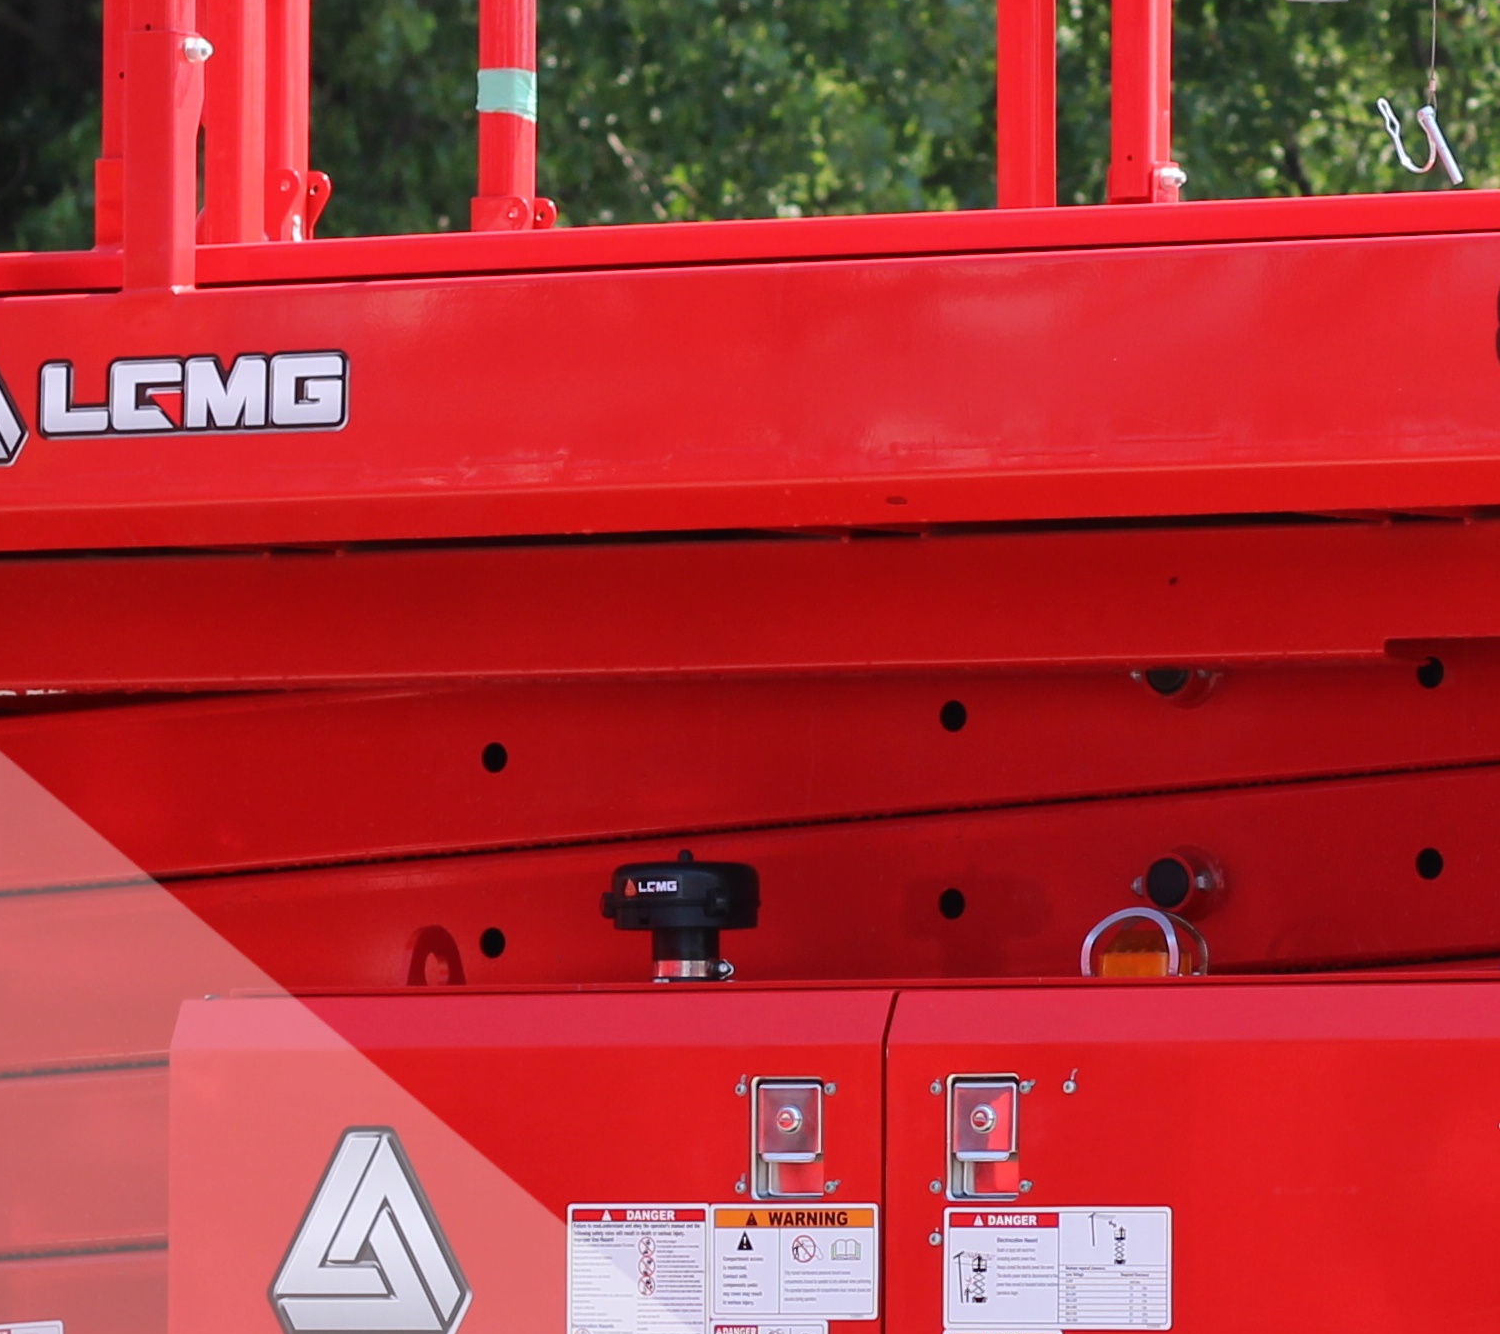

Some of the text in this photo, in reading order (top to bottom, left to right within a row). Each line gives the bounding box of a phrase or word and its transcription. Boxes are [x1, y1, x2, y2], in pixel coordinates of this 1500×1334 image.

[626, 1210, 675, 1221] DANGER
[768, 1212, 848, 1226] WARNING
[988, 1215, 1037, 1226] DANGER
